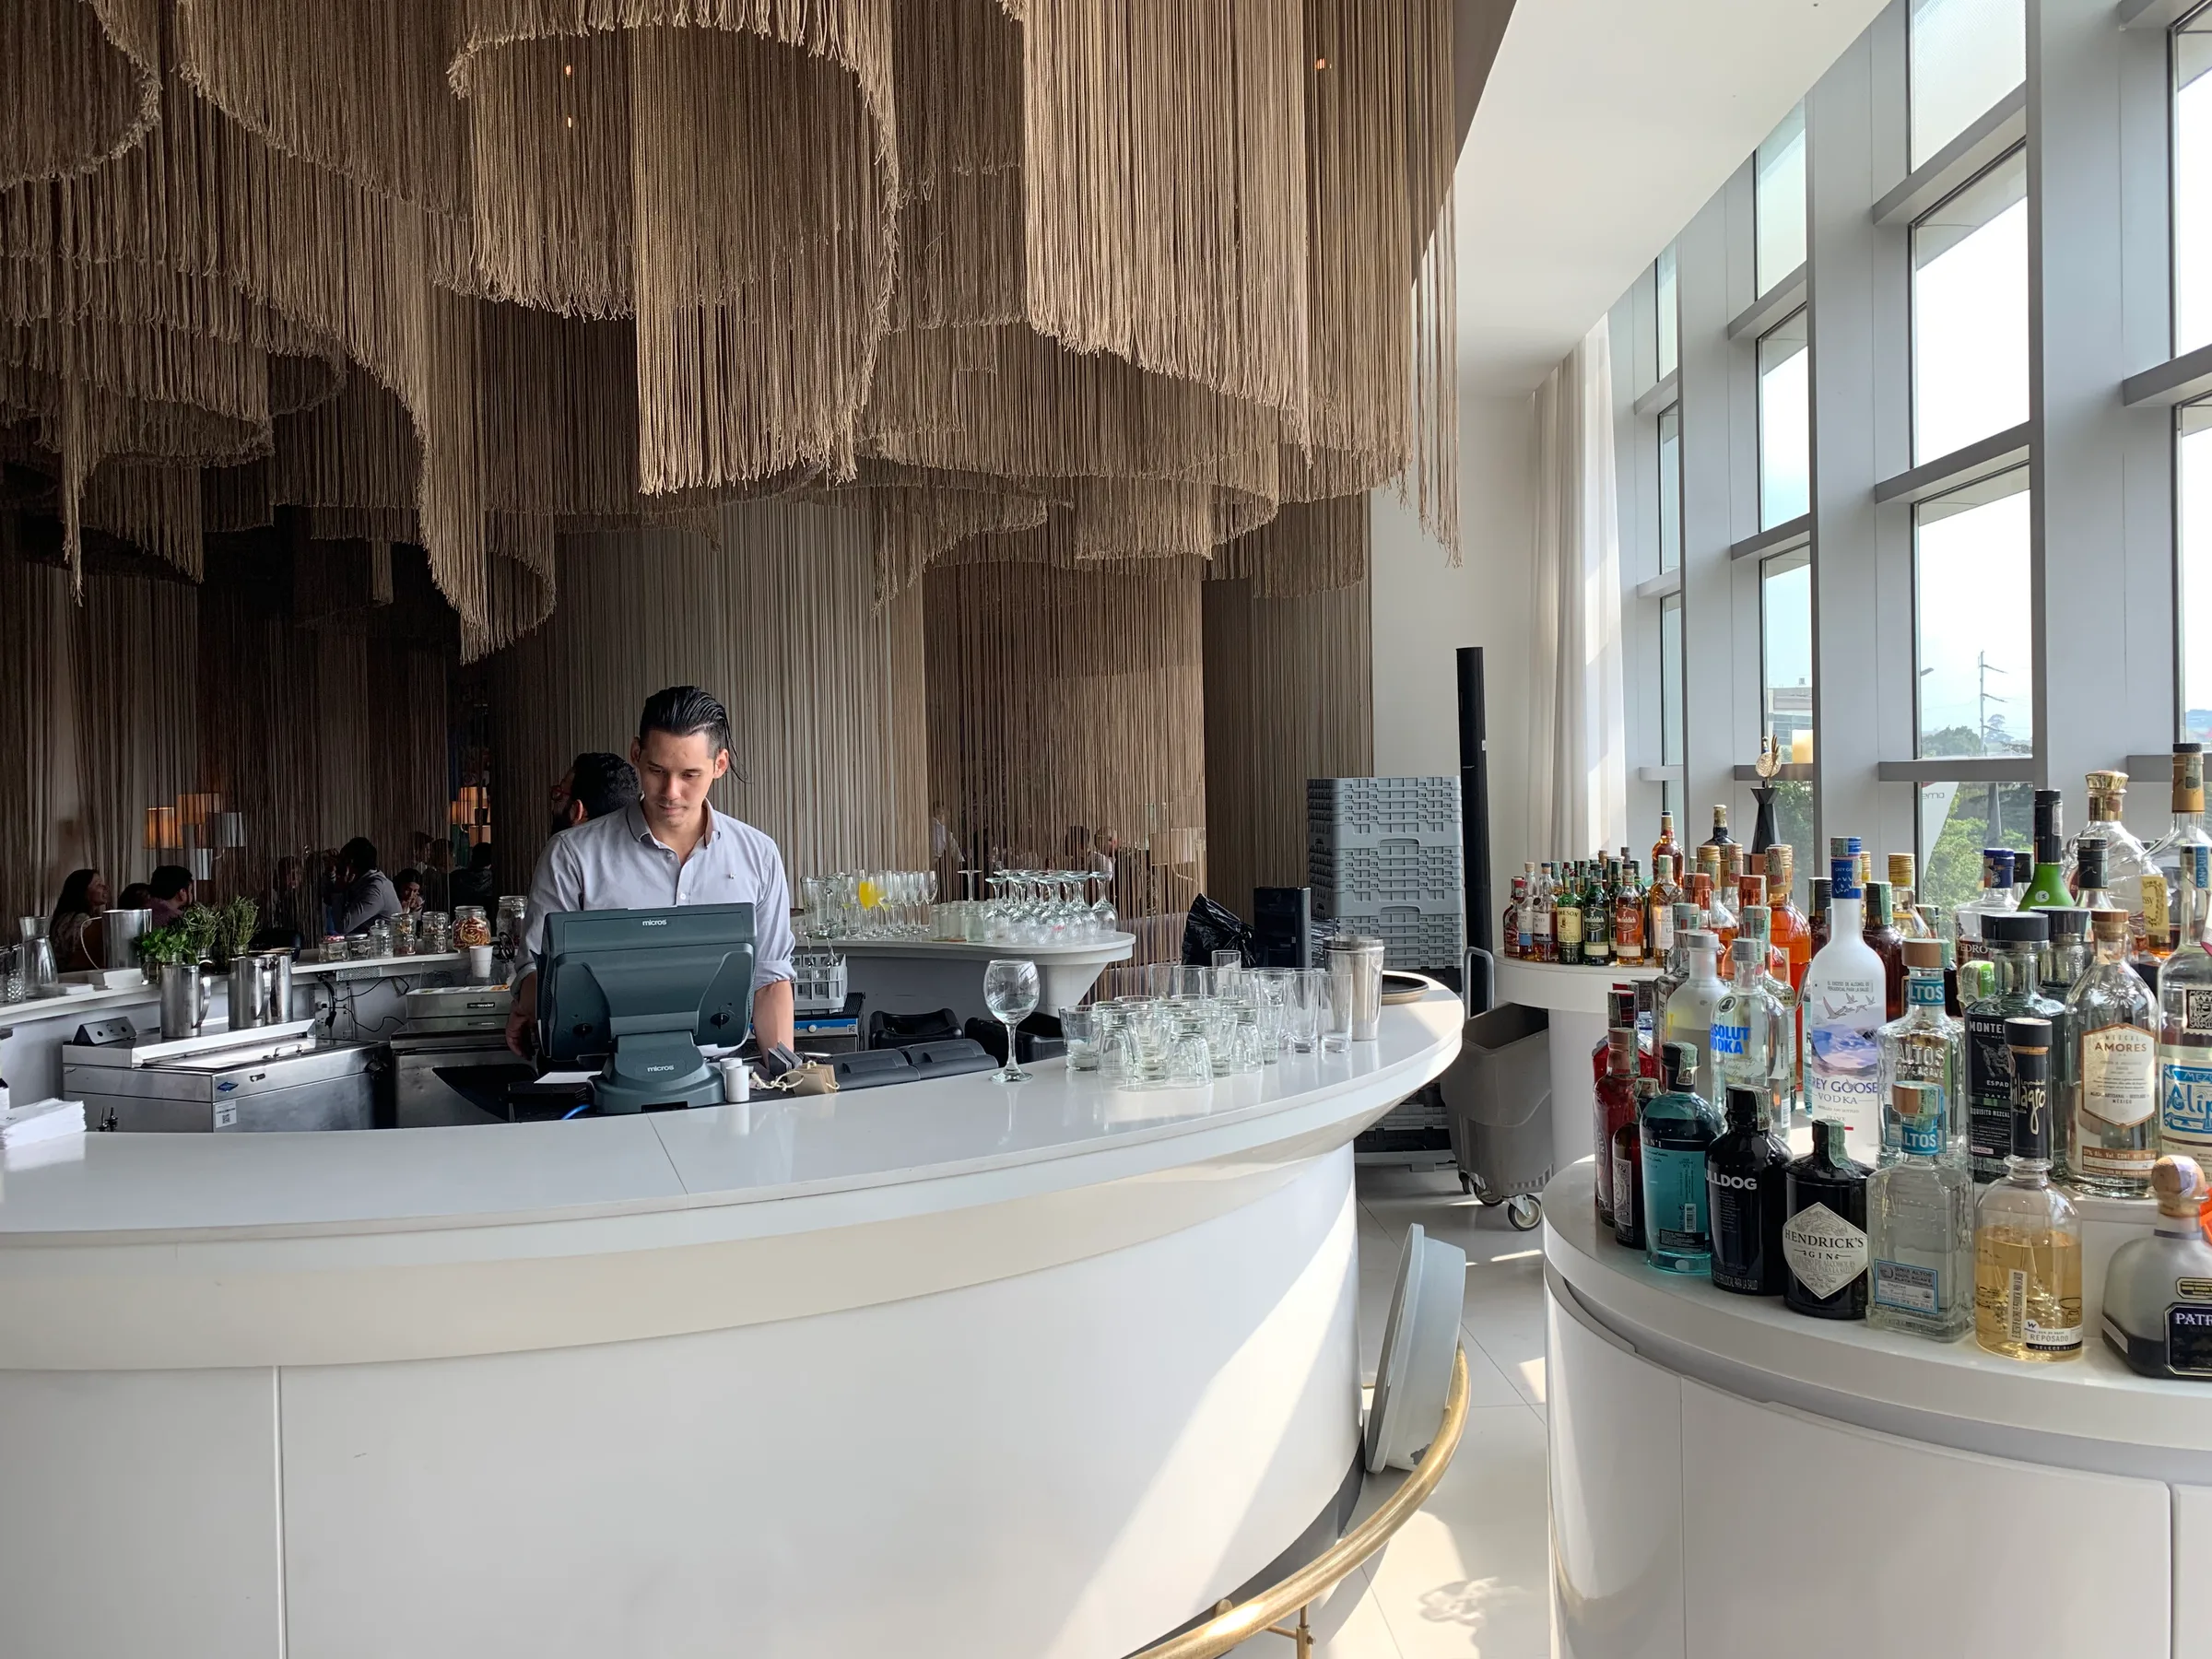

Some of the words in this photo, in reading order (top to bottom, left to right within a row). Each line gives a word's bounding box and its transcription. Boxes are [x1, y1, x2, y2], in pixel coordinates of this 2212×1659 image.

[1957, 942, 1988, 955] PEDRO
[1911, 985, 1944, 1001] LTOS
[2095, 1042, 2147, 1052] AMORES
[1896, 1043, 1945, 1067] ALTOS
[647, 1064, 675, 1072] micros
[1830, 1081, 1878, 1094] GOOSE
[1818, 1092, 1858, 1105] VODKA
[1902, 1133, 1936, 1147] LTOS
[1705, 1169, 1757, 1190] ULLDOG
[1784, 1228, 1864, 1249] HENDRICK'S
[1808, 1251, 1833, 1260] GIN
[2176, 1312, 2212, 1325] PATR
[2030, 1334, 2069, 1342] REPOSADO
